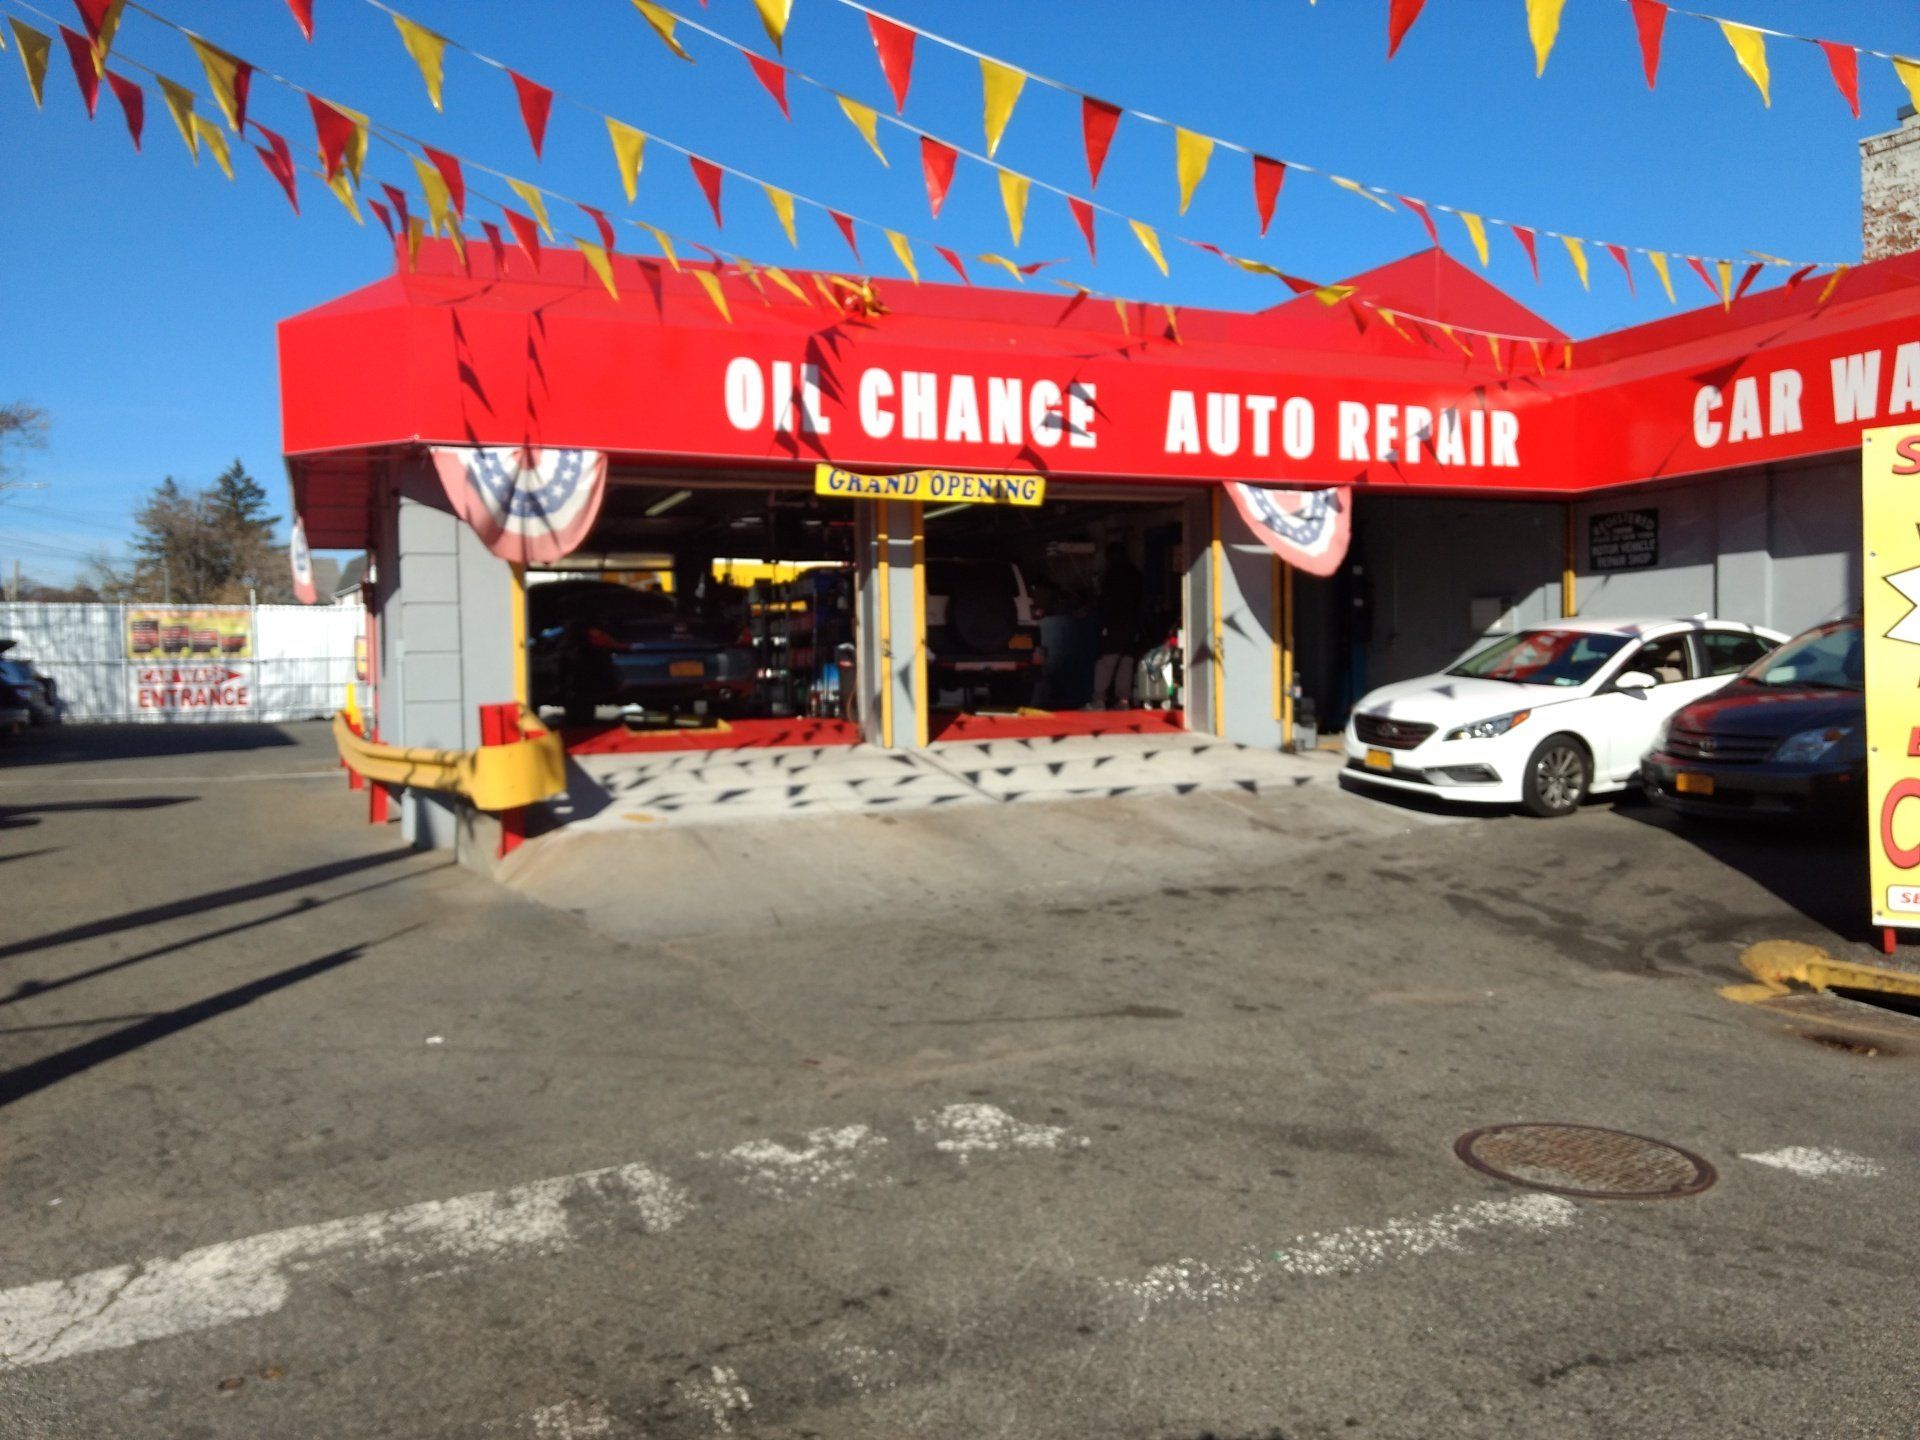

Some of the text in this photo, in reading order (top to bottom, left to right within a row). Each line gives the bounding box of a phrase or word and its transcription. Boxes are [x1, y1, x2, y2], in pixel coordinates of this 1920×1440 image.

[724, 357, 1098, 449] OIL CHANGE
[1164, 389, 1520, 468] AUTO REPAIR
[1693, 368, 1803, 448] CAR
[829, 469, 1036, 500] GRAND OPENING
[138, 687, 248, 708] ENTRANCE
